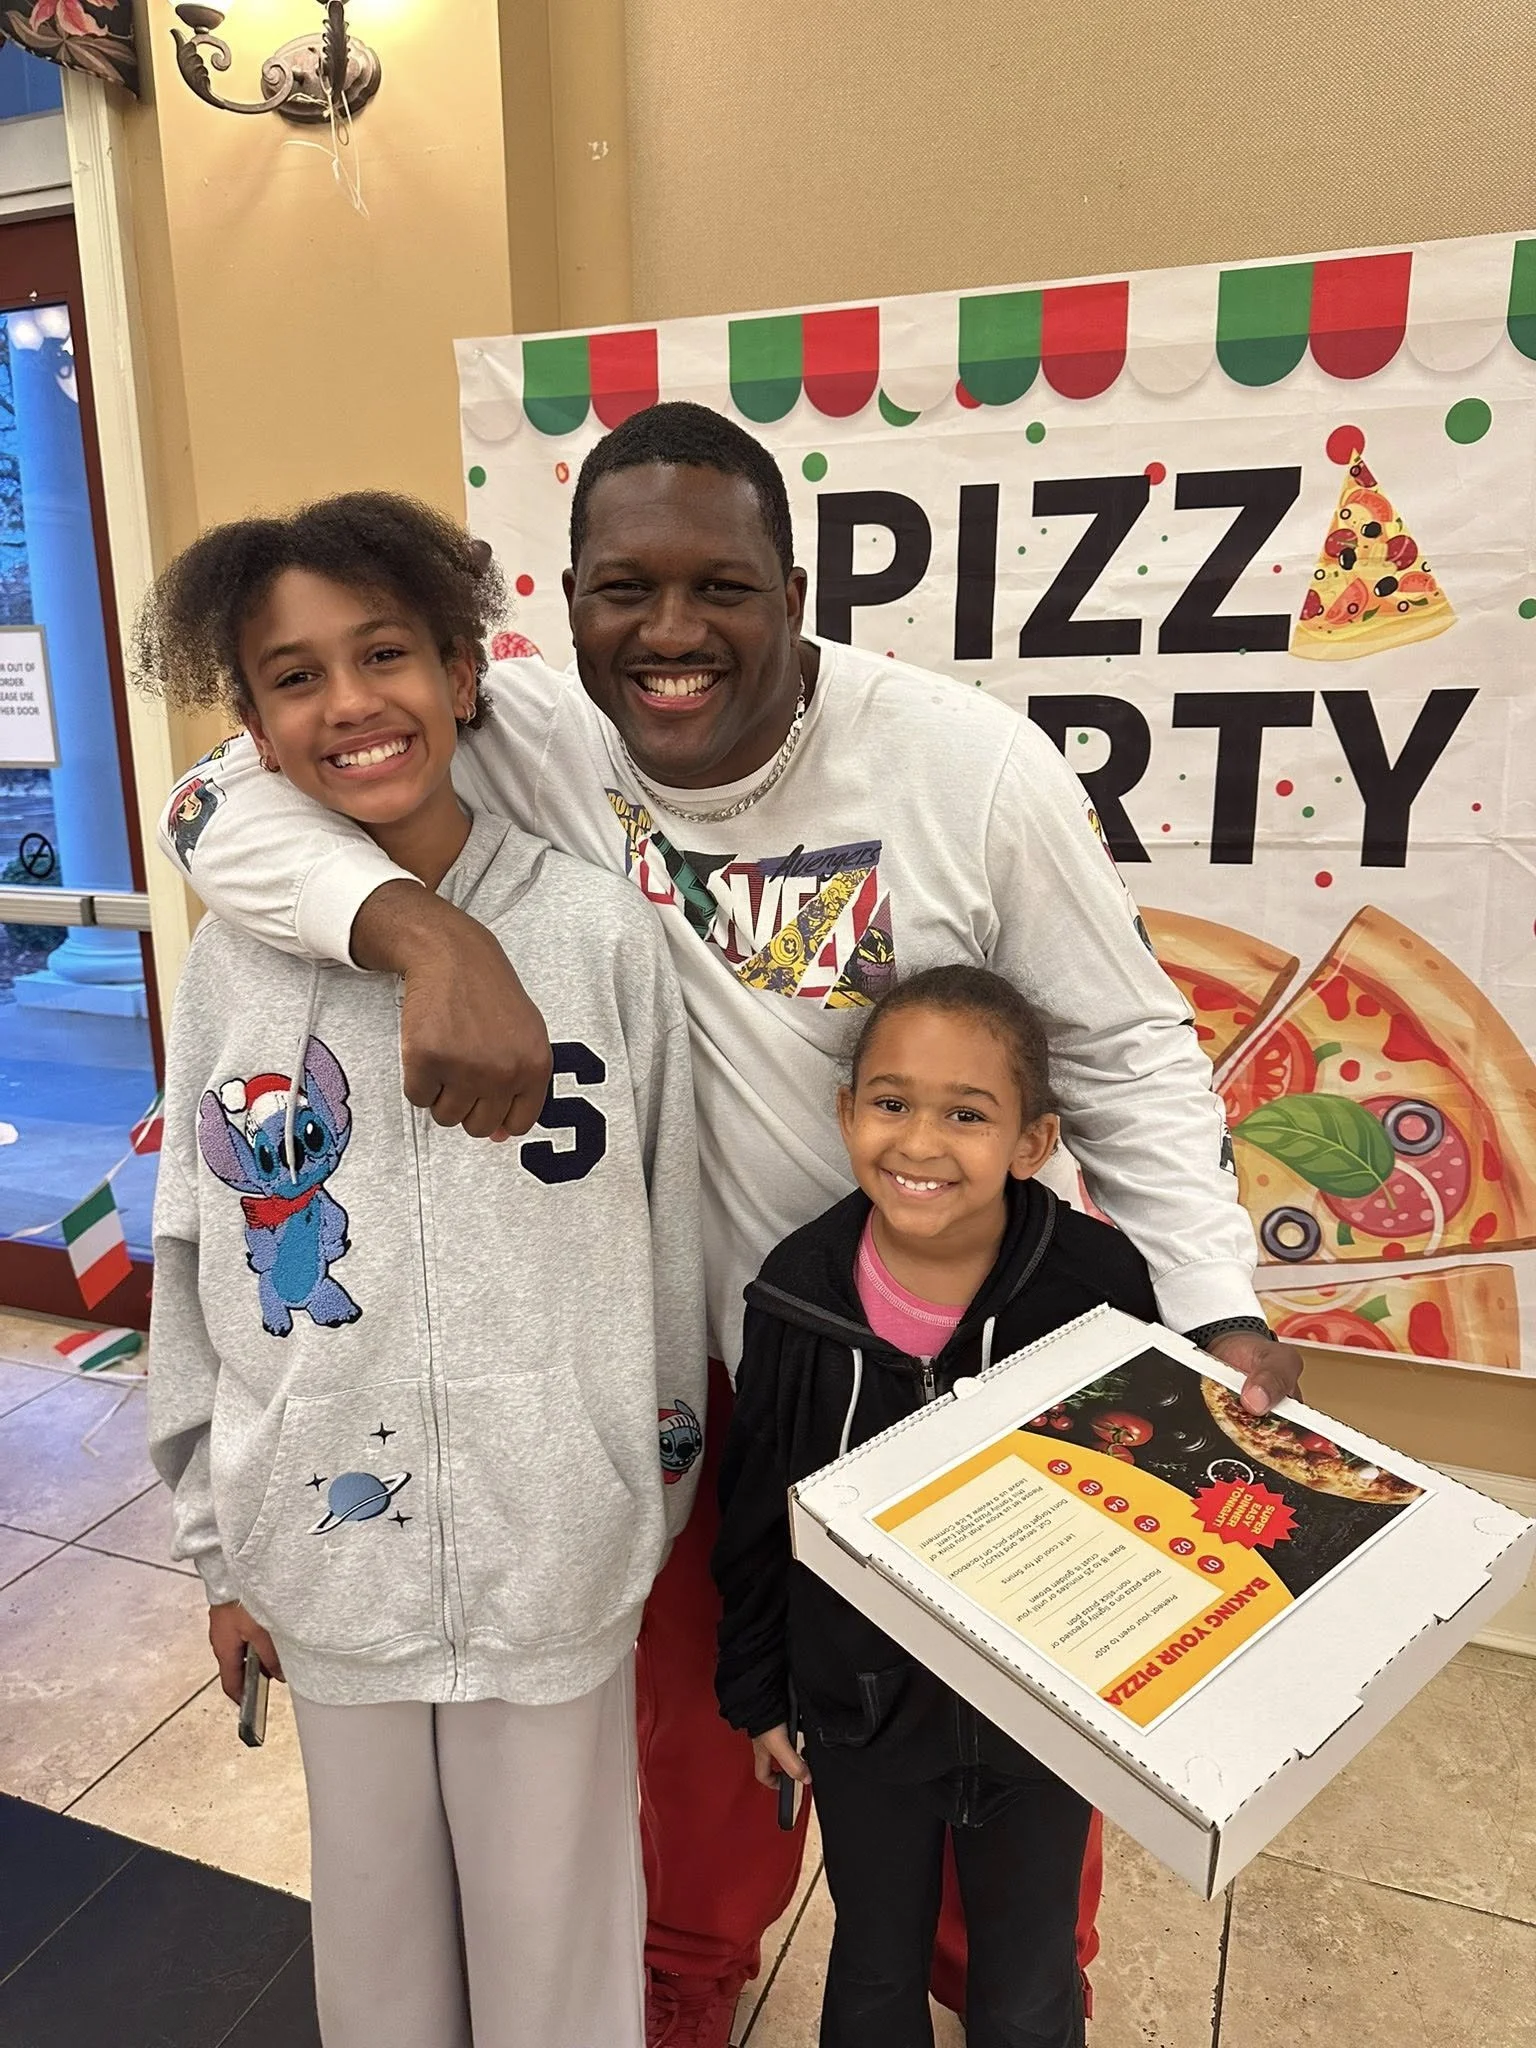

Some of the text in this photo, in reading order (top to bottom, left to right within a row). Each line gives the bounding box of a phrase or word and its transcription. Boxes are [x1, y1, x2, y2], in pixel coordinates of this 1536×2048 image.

[7, 663, 24, 673] OUT
[1026, 687, 1480, 868] RTY
[768, 843, 883, 884] Avengers
[518, 1038, 608, 1186] S
[1052, 1462, 1069, 1474] 06
[1007, 1477, 1029, 1492] Leave
[1083, 1482, 1100, 1495] 05
[1011, 1488, 1026, 1498] this
[1020, 1485, 1044, 1502] Please
[989, 1496, 1014, 1513] Family
[1108, 1499, 1126, 1511] 04
[1212, 1486, 1246, 1528] TONIGHT!
[1226, 1493, 1254, 1528] DINNER
[973, 1510, 993, 1524] Pizza
[985, 1511, 1005, 1525] know
[1029, 1509, 1053, 1526] forget
[1242, 1502, 1263, 1528] EASY
[1250, 1504, 1276, 1535] SUPER
[955, 1521, 976, 1536] Night
[967, 1523, 986, 1537] what
[1139, 1518, 1157, 1531] 03
[954, 1533, 969, 1545] you
[1006, 1527, 1024, 1541] post
[1063, 1532, 1077, 1543] Let
[937, 1542, 956, 1556] think
[991, 1537, 1008, 1550] pics
[1002, 1541, 1019, 1554] and
[1042, 1544, 1059, 1557] cool
[1107, 1544, 1127, 1558] Bake
[1173, 1541, 1192, 1554] 02
[978, 1550, 1006, 1570] ENJOY!
[1023, 1561, 1036, 1571] for
[1032, 1554, 1044, 1565] off
[1080, 1553, 1100, 1567] crust
[1204, 1559, 1220, 1571] 01
[947, 1554, 985, 1581] Facebook!
[1082, 1567, 1095, 1577] 25
[1141, 1567, 1162, 1583] Place
[1049, 1569, 1076, 1589] golden
[1055, 1573, 1085, 1595] minutes
[1028, 1586, 1053, 1604] brown
[1123, 1579, 1143, 1596] pizza
[1031, 1598, 1049, 1613] until
[1065, 1578, 1132, 1627] non-stick pizza pan
[1114, 1593, 1126, 1603] on
[1149, 1593, 1179, 1615] Preheat
[1015, 1608, 1033, 1623] your
[1086, 1604, 1112, 1623] lightly
[1135, 1611, 1153, 1627] your
[1058, 1618, 1089, 1644] greased
[1117, 1624, 1137, 1640] oven
[1050, 1640, 1060, 1650] or
[1102, 1576, 1271, 1706] BAKING YOUR PIZZA
